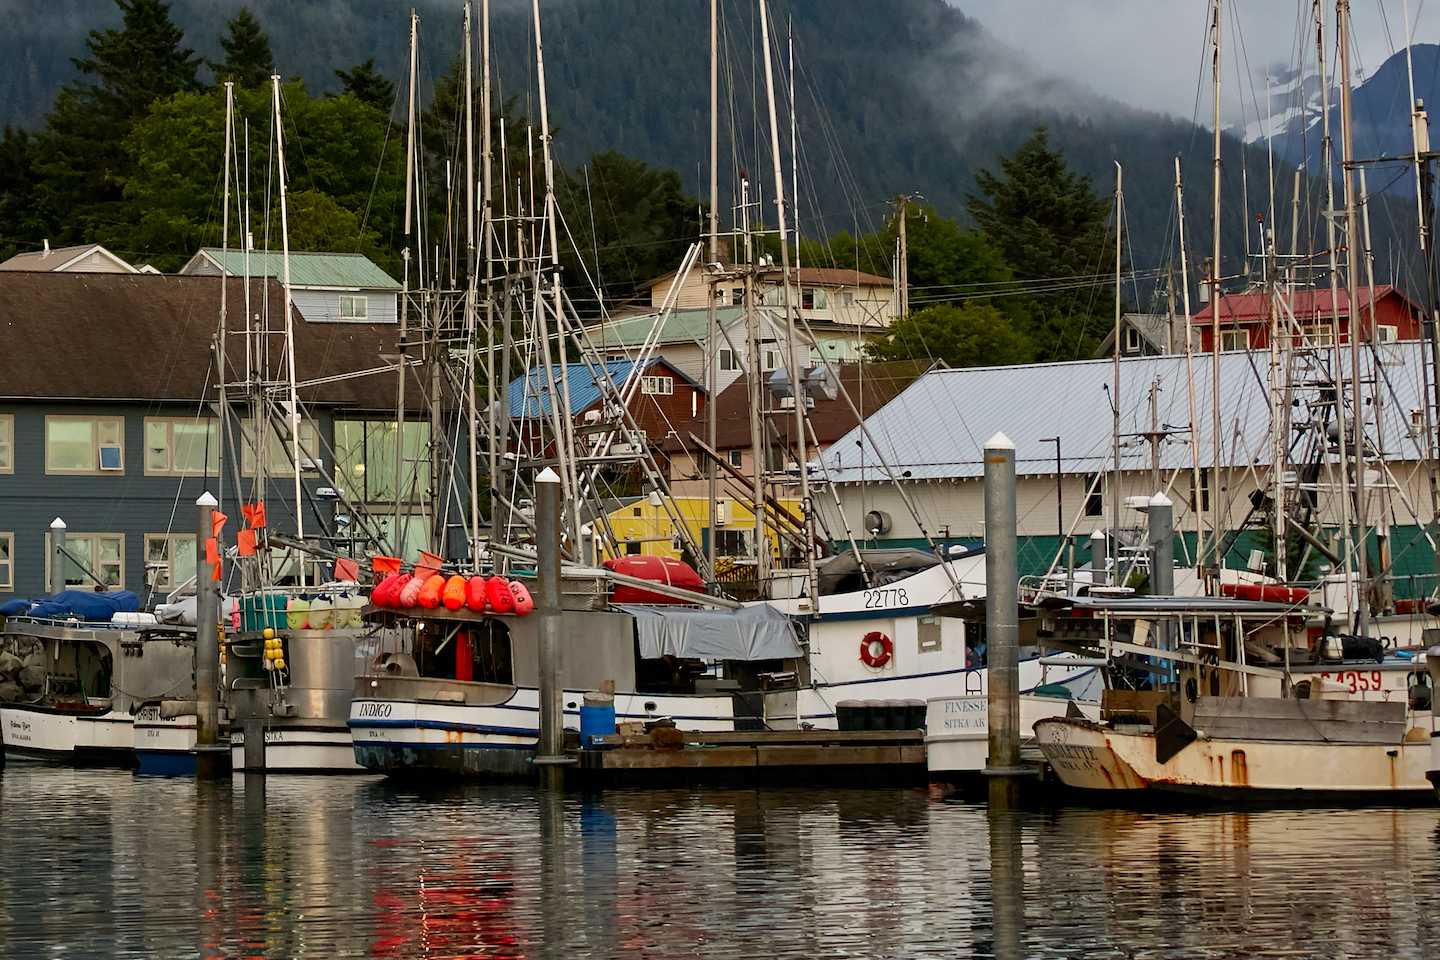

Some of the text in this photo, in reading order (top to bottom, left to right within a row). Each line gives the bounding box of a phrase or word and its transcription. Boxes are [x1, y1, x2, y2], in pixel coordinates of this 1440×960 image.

[864, 588, 909, 608] 22778
[360, 704, 392, 717] INDIGO
[944, 700, 986, 713] FINESSE
[944, 718, 985, 728] SITKA AK
